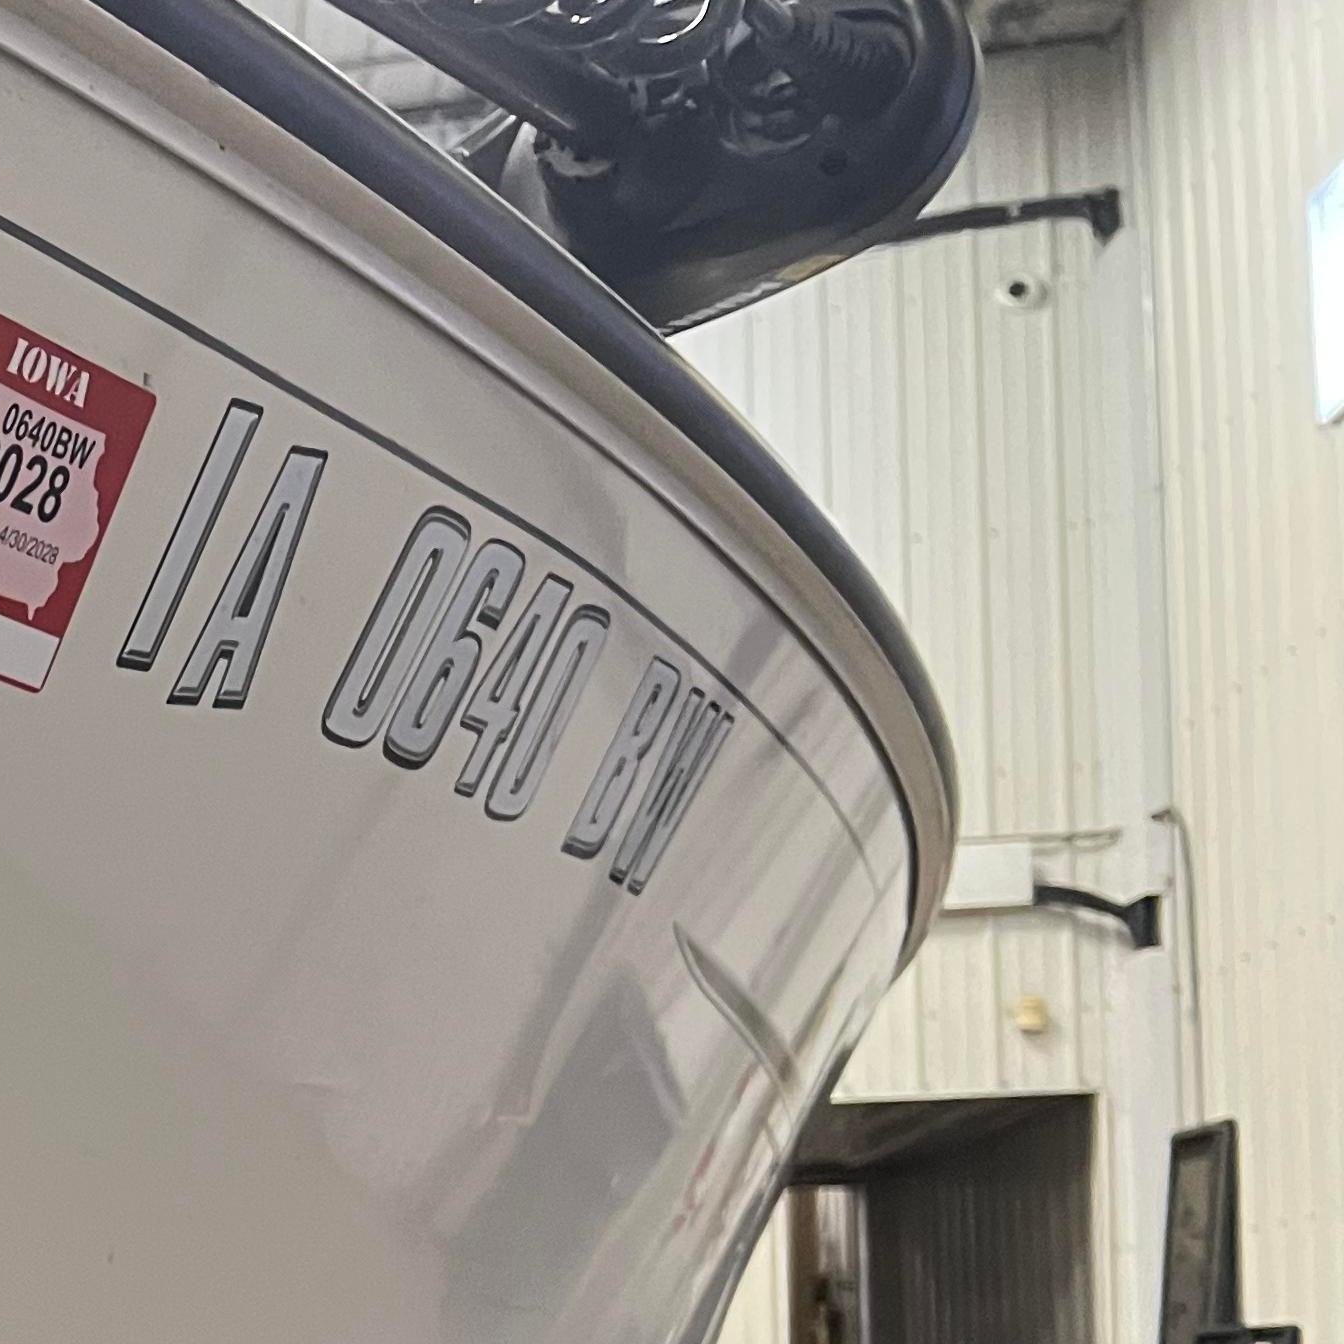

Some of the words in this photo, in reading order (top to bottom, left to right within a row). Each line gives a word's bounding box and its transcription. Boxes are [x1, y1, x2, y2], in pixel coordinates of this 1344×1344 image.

[7, 338, 90, 408] IOWA
[2, 403, 96, 469] 0640BW
[116, 397, 328, 709] IA
[321, 504, 611, 822] 0640
[560, 655, 735, 896] BW
